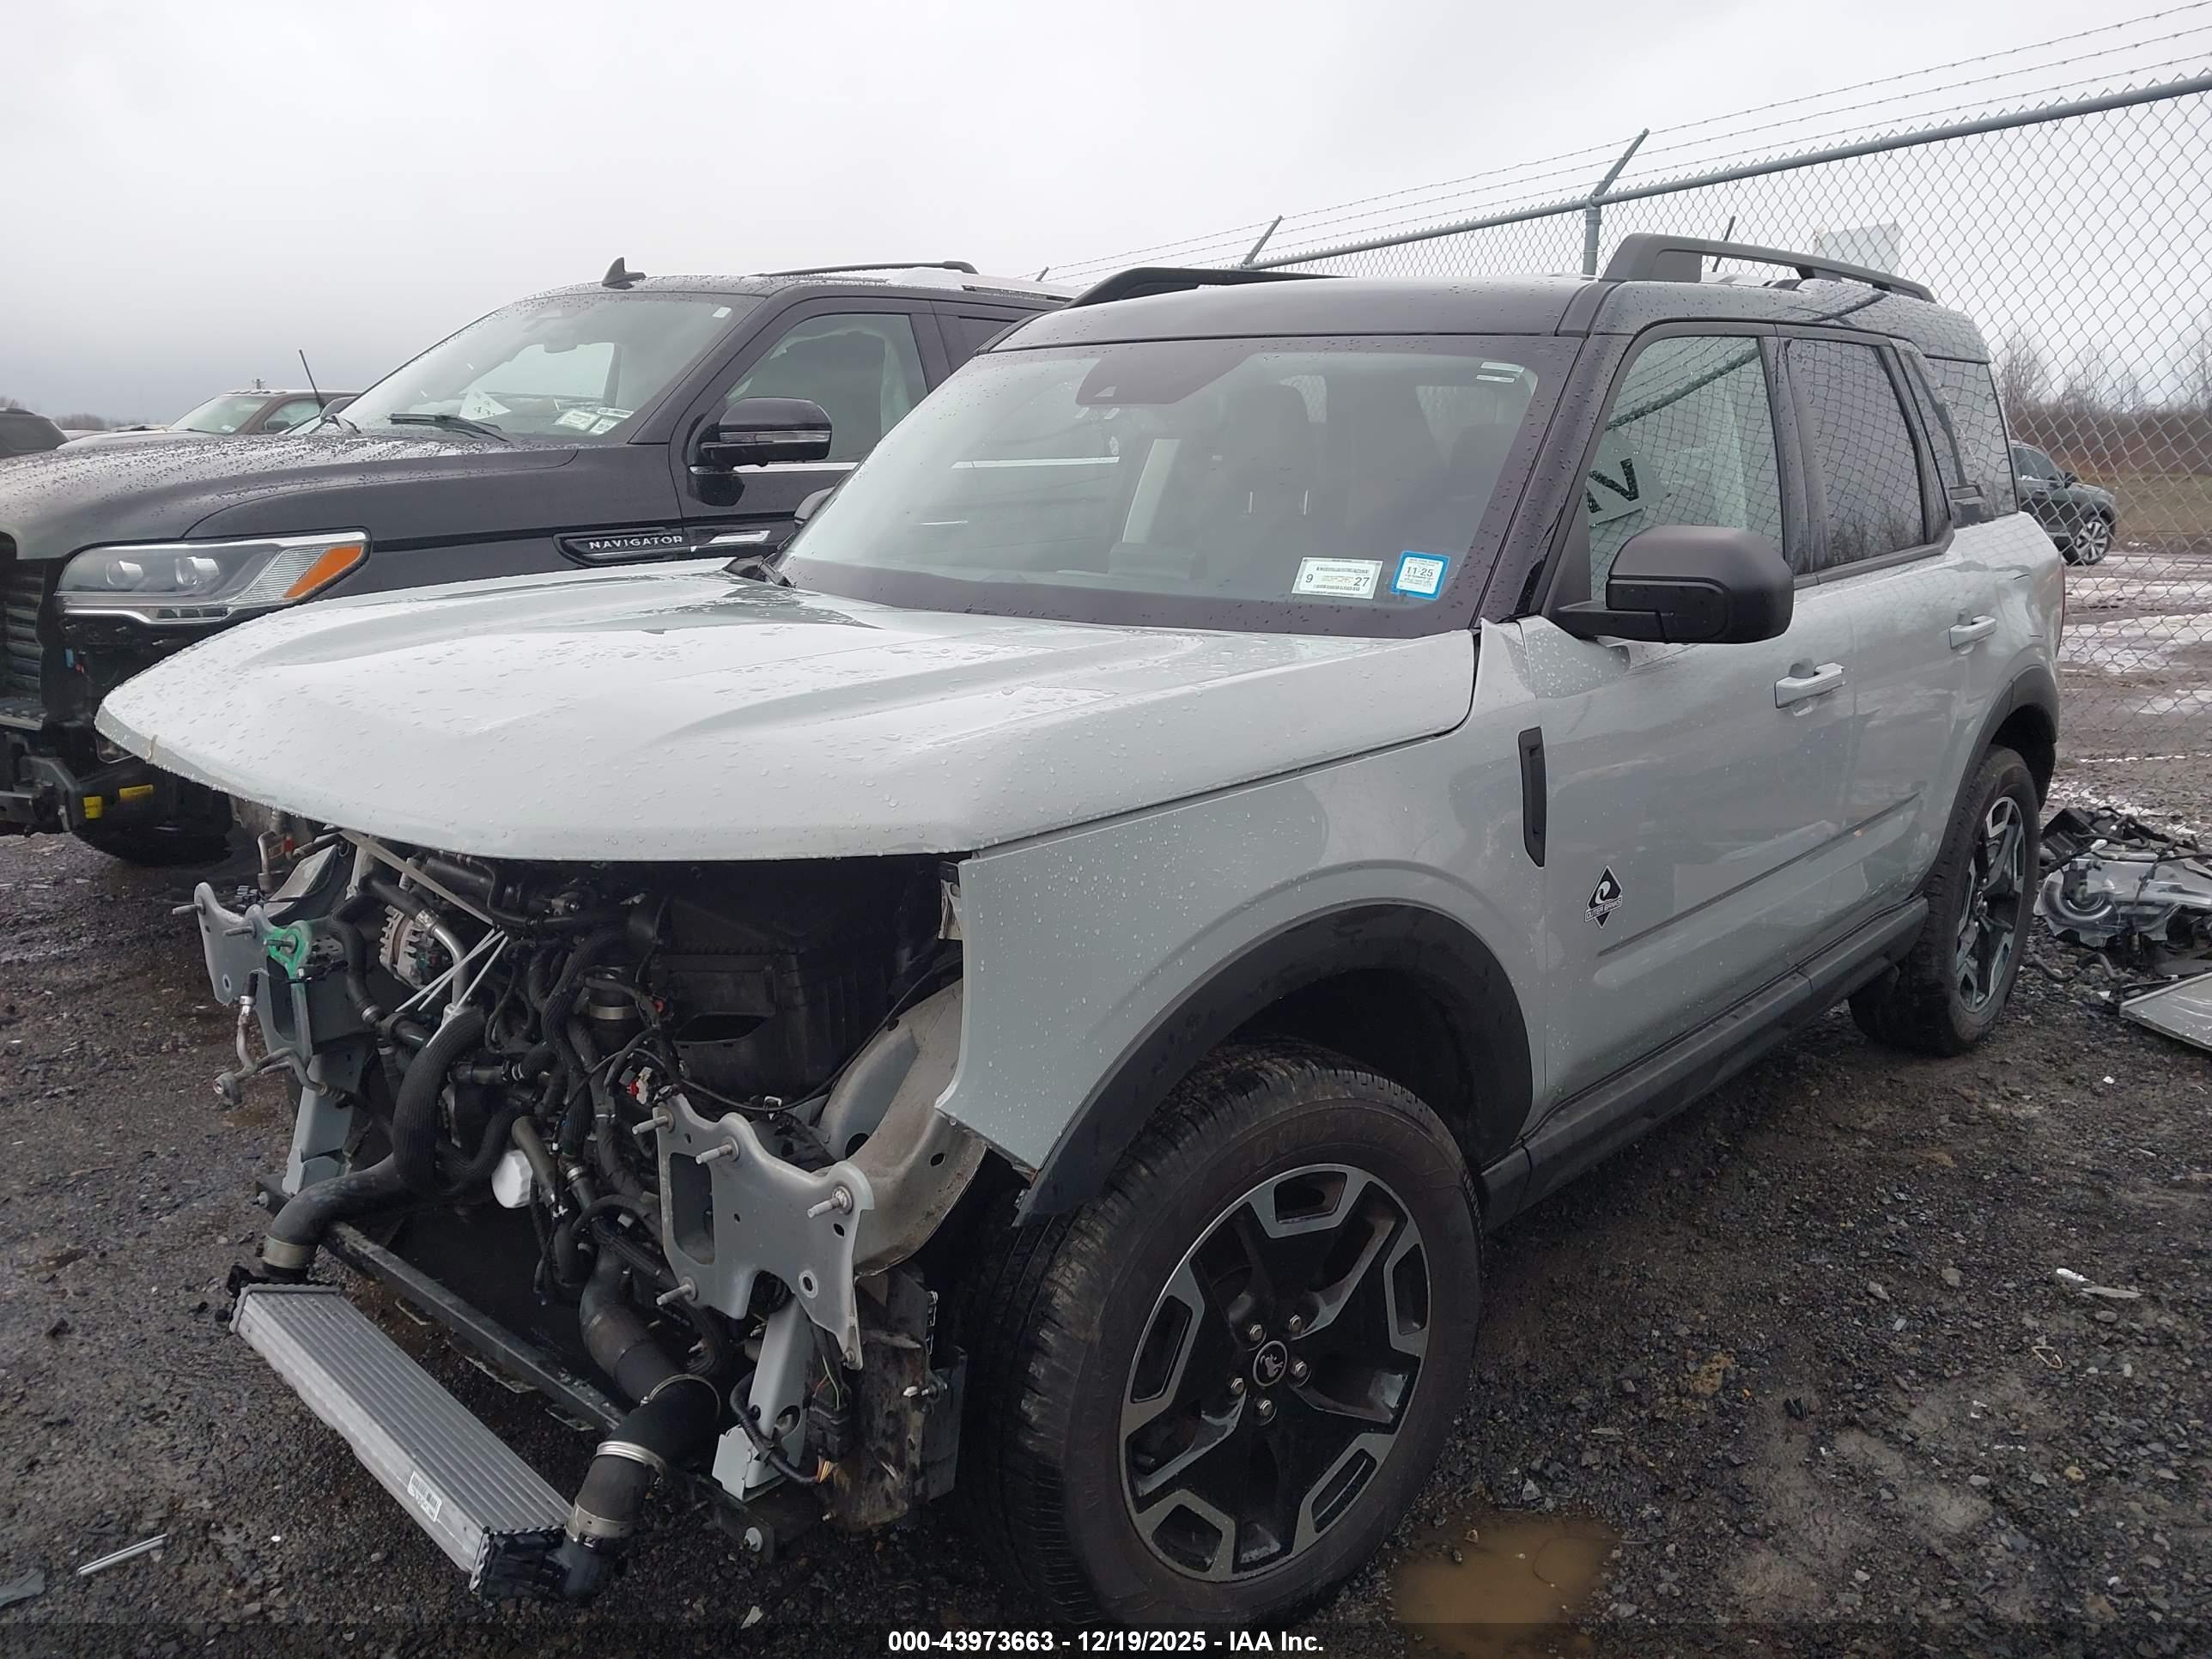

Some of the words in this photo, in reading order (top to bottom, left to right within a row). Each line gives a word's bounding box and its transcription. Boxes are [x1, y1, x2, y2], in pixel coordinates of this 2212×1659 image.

[588, 534, 684, 550] NAVIGATOR
[1407, 566, 1418, 574] 11
[1420, 567, 1435, 577] 25
[1305, 574, 1314, 583] 9
[1352, 576, 1370, 587] 27
